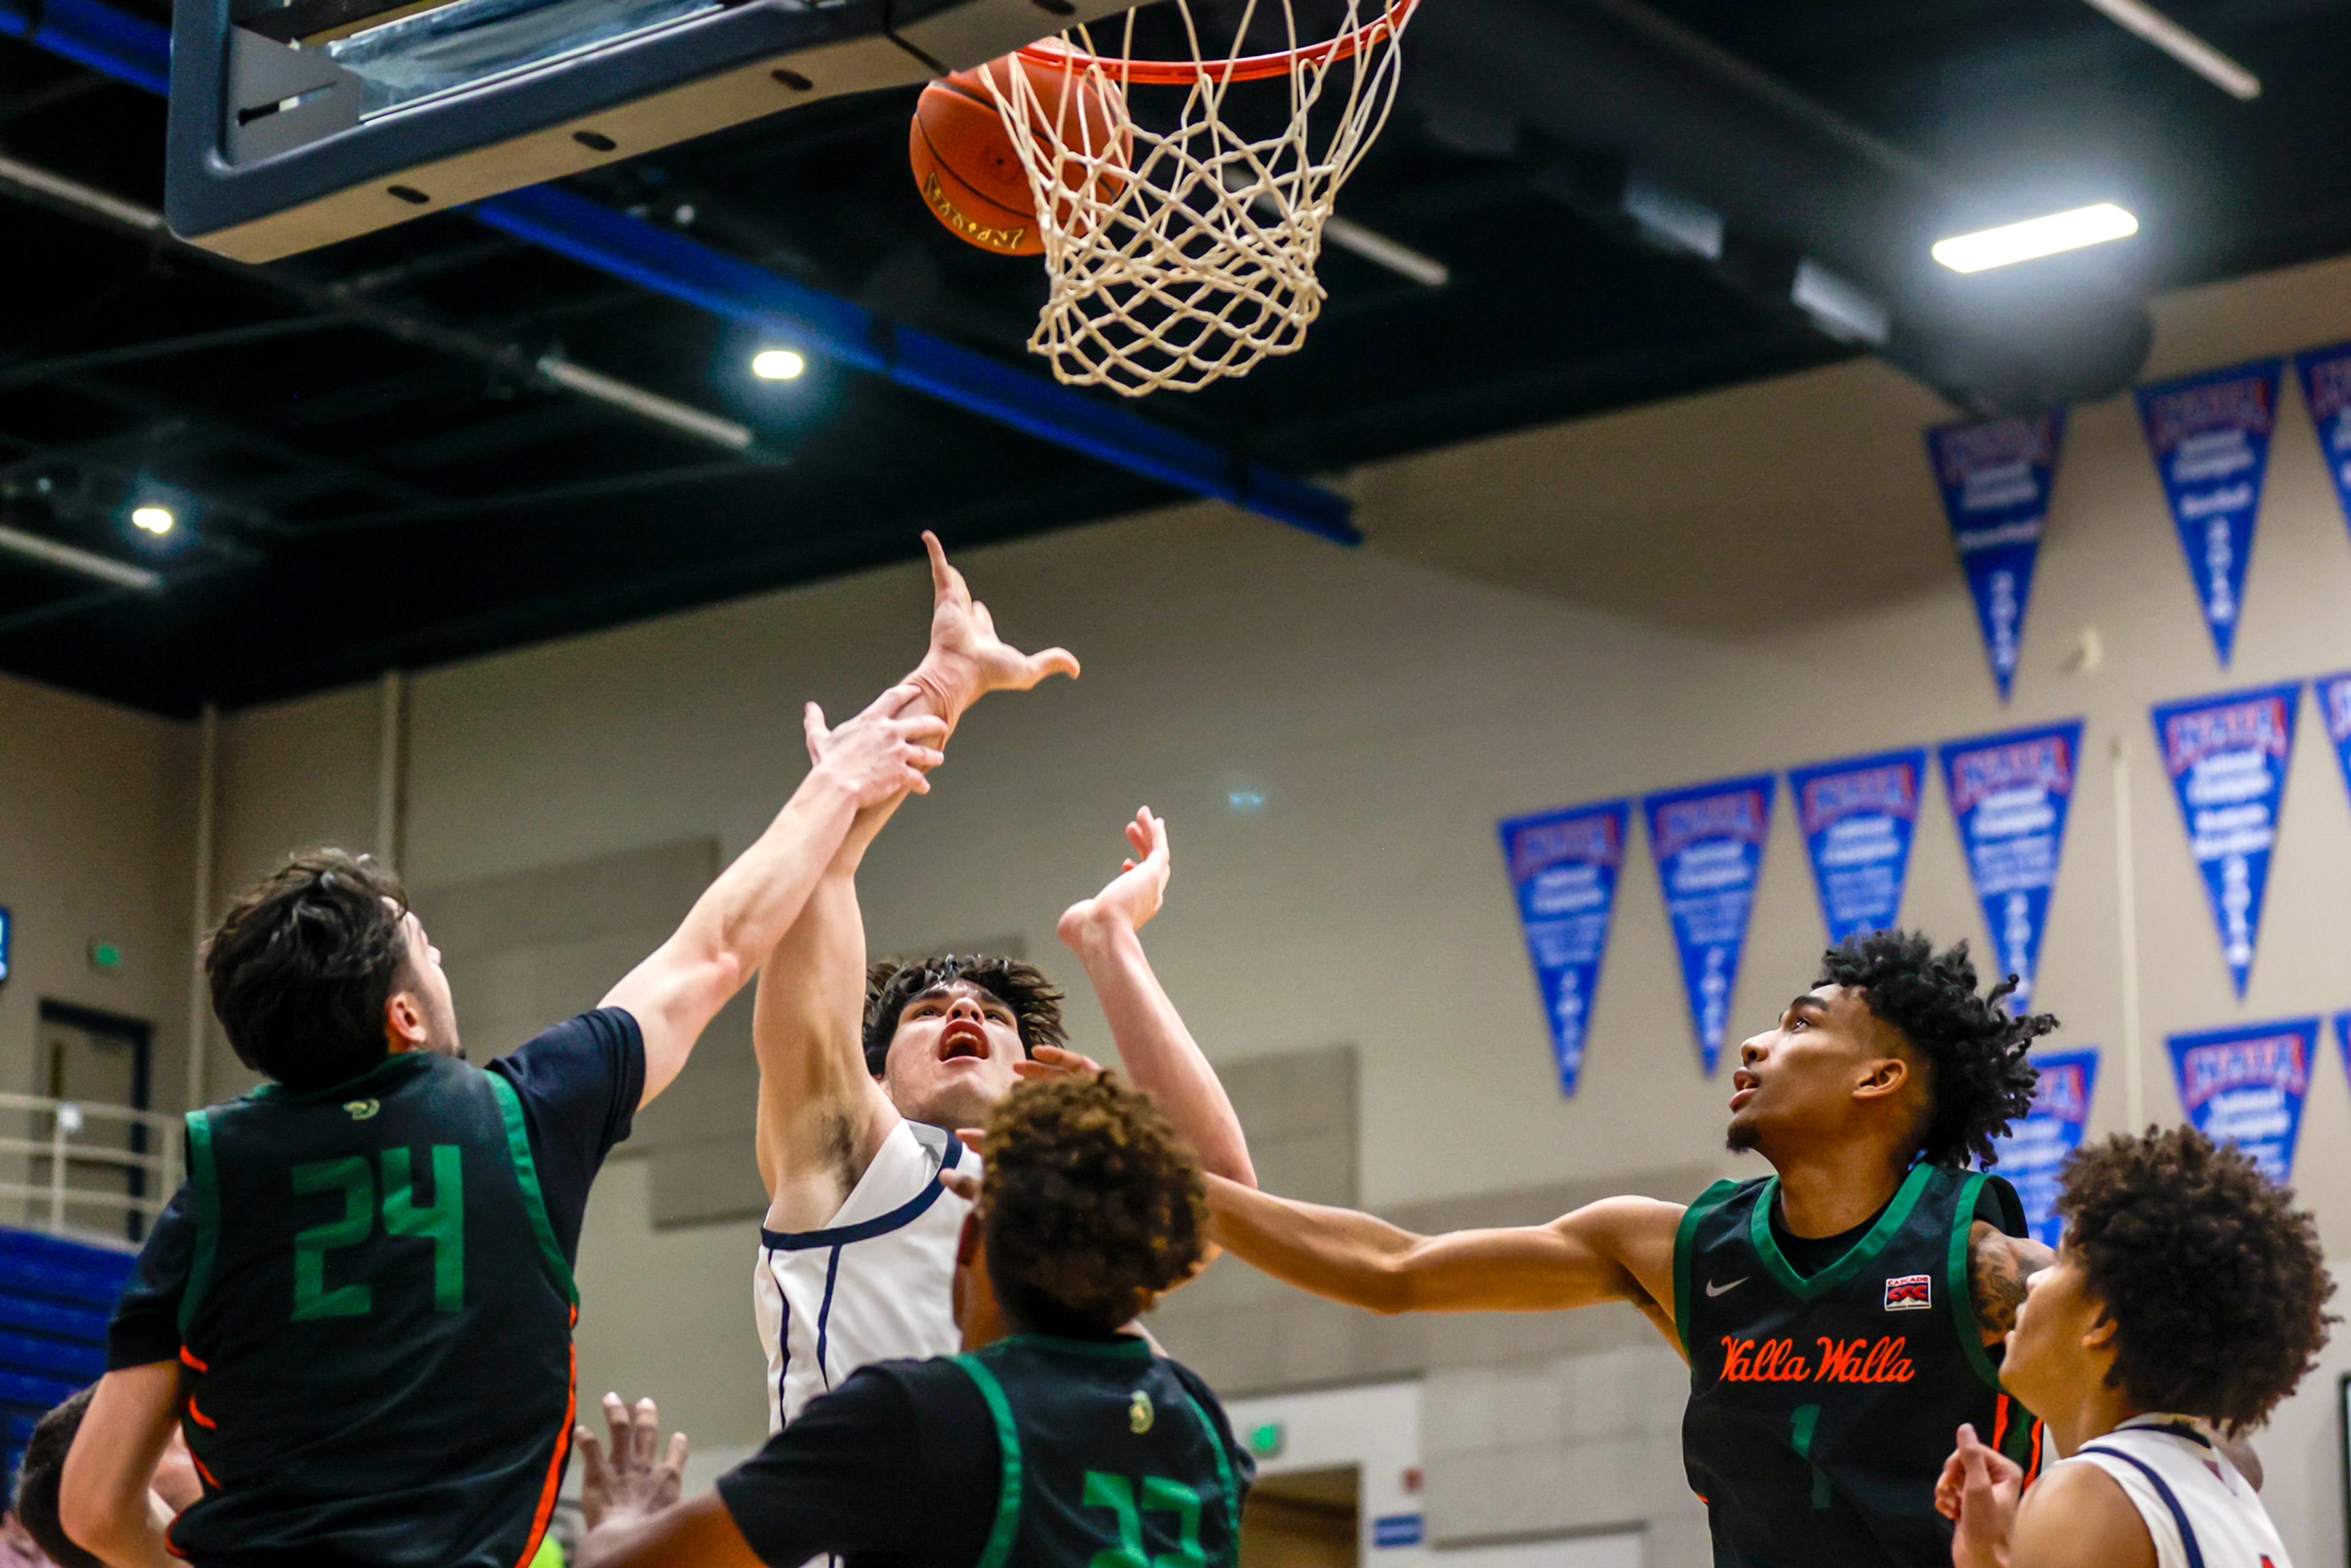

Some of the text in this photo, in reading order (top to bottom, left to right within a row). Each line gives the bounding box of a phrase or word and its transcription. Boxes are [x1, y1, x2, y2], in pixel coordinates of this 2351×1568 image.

[291, 1144, 464, 1321] 24
[1888, 1277, 1929, 1286] CASCADE
[1888, 1285, 1927, 1300] CCC
[1813, 1336, 1915, 1384] Walla
[1790, 1405, 1832, 1510] 1
